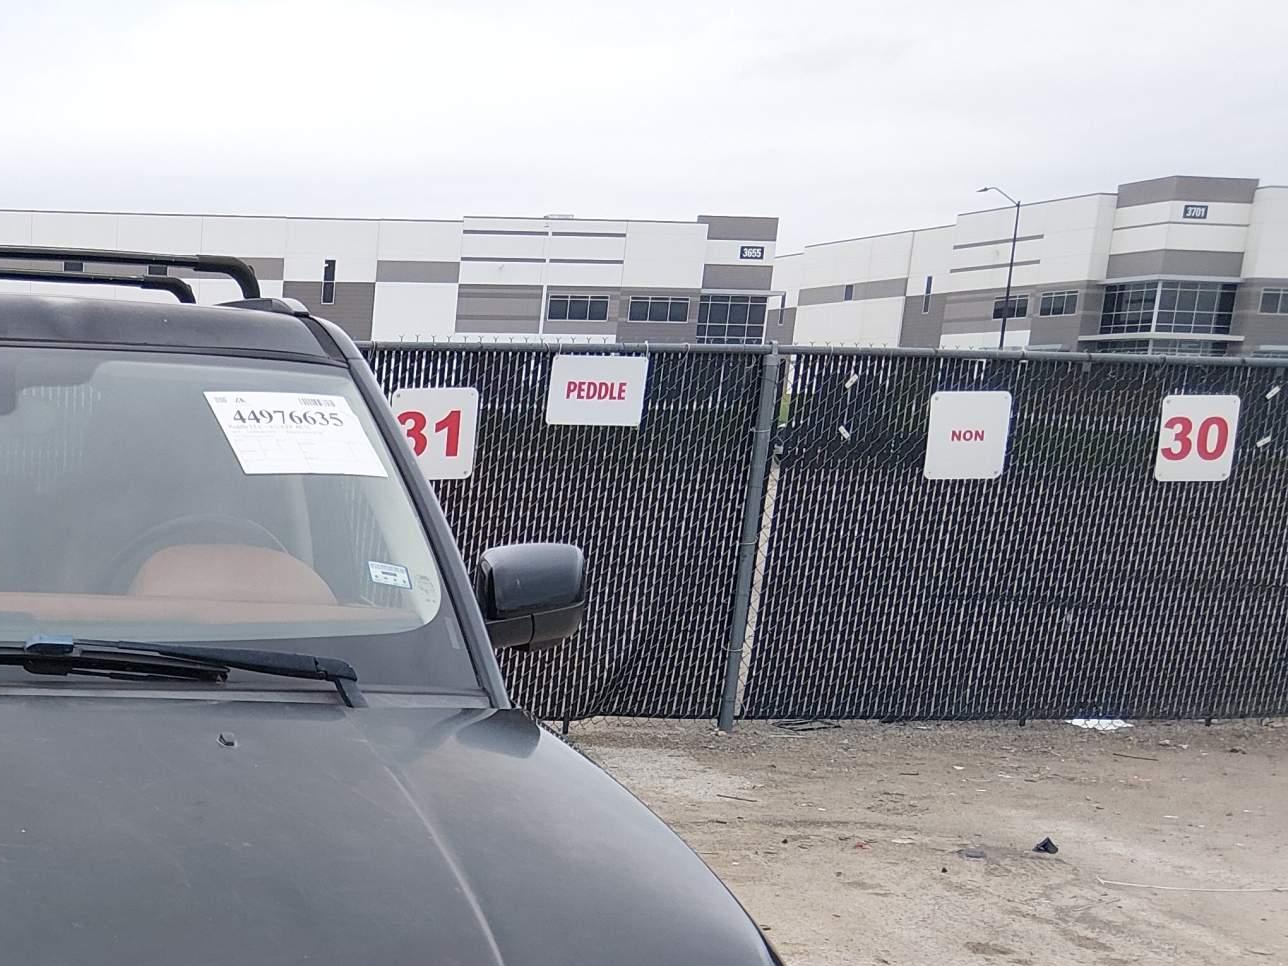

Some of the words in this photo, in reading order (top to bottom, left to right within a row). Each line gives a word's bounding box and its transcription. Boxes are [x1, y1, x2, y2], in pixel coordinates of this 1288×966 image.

[1185, 206, 1207, 217] 3701
[742, 247, 762, 258] 3655
[565, 380, 627, 400] PEDDLE
[233, 408, 344, 427] 44976635
[397, 410, 461, 457] 31
[951, 430, 985, 442] NON
[1160, 416, 1229, 461] 30
